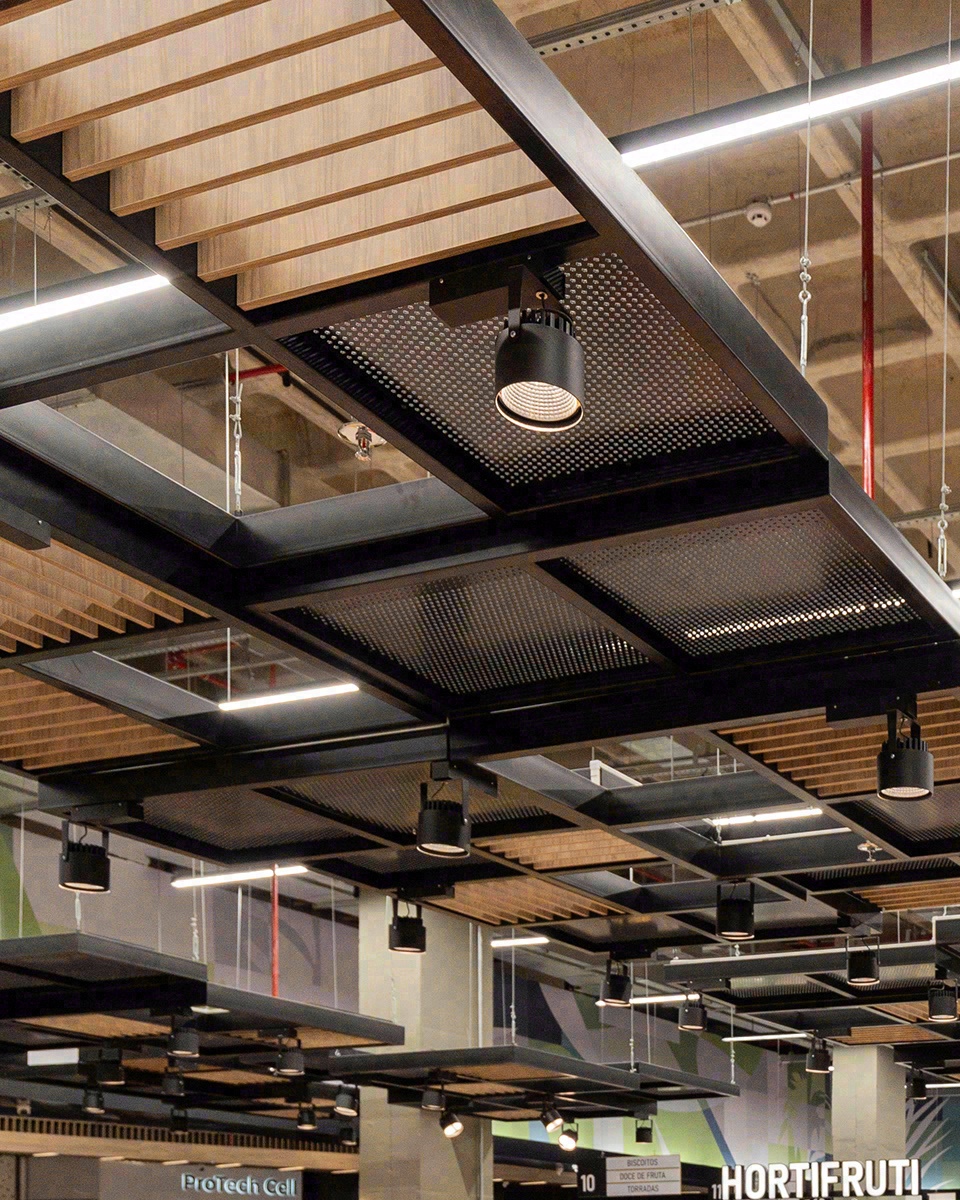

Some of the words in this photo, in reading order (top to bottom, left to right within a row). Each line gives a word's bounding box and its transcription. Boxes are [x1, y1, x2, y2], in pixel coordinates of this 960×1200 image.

[627, 1159, 658, 1167] BISCOITOS
[580, 1174, 596, 1193] 10
[620, 1173, 635, 1181] DOCE
[647, 1171, 666, 1180] FRUTA
[721, 1159, 920, 1200] HORTIFRUTI
[181, 1172, 258, 1196] ProTech
[263, 1177, 297, 1197] Cell
[627, 1185, 659, 1193] TORRADAS
[711, 1184, 722, 1200] 11
